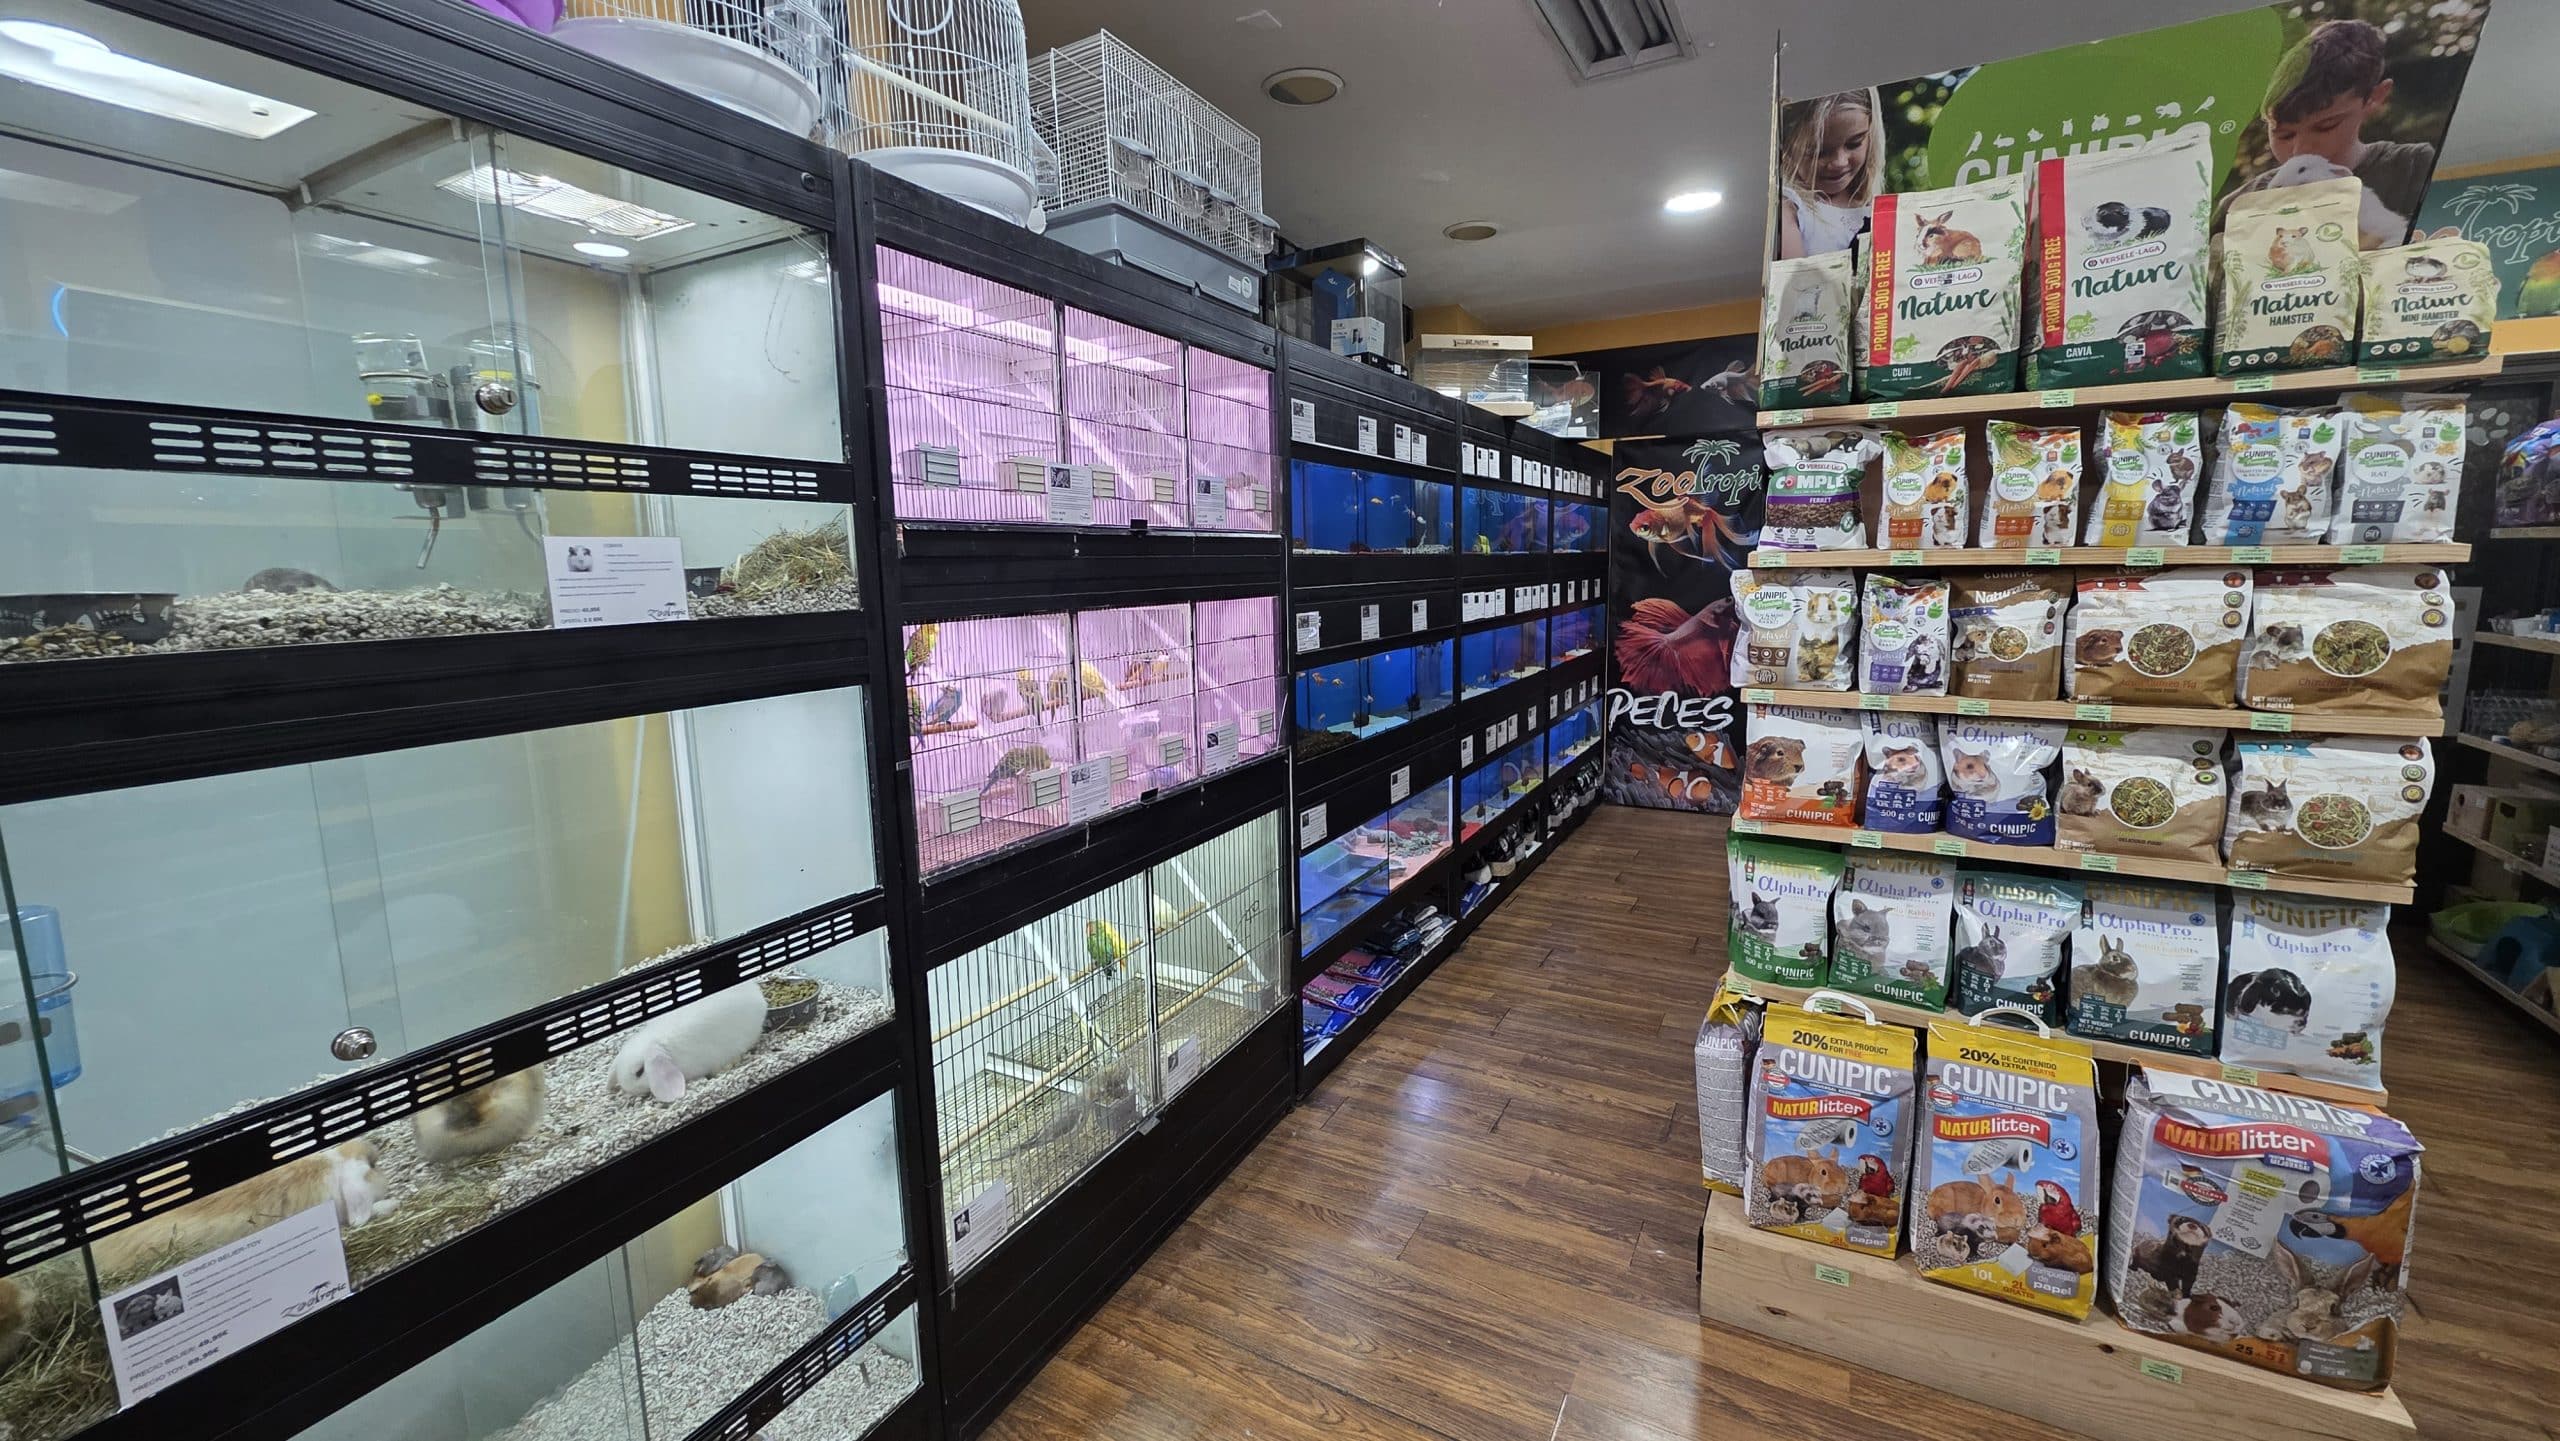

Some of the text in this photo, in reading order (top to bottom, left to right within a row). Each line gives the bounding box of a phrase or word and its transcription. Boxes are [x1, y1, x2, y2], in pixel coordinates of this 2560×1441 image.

[2044, 236, 2060, 258] FREE
[2099, 245, 2161, 265] VERSELE-LAGA
[1876, 250, 1891, 278] FREE
[2046, 268, 2061, 290] 500
[2072, 261, 2184, 298] Nature
[1880, 288, 1890, 309] 500
[1898, 288, 1998, 320] Nature
[2251, 290, 2339, 316] Nature
[2392, 293, 2474, 313] Nature
[2046, 290, 2061, 332] PROMO
[2270, 313, 2314, 327] HAMSTER
[2401, 310, 2459, 322] MINI HAMSTER
[1874, 311, 1888, 351] PROMO
[1780, 334, 1838, 352] Nature
[2066, 346, 2092, 358] CAVIA
[1892, 368, 1912, 378] CUNI
[2244, 450, 2276, 458] CUNIPIC
[2364, 450, 2400, 458] CUNIPIC
[1754, 591, 1787, 600] CUNIPIC
[1606, 687, 1734, 732] PECES
[1818, 710, 1842, 722] Pro
[1786, 809, 1834, 822] CUNIPIC
[1990, 823, 2036, 834] CUNIPIC
[1758, 875, 1804, 897] Alpha
[1858, 877, 1932, 898] Alpha Pro
[1980, 900, 2066, 928] Alpha Pro
[2251, 896, 2369, 928] CUNIPIC
[2099, 912, 2192, 937] Alpha Pro
[2267, 932, 2352, 955] Alpha Pro
[1776, 966, 1814, 978] CUNIPIC
[1874, 984, 1924, 1002] CUNIPIC
[1792, 1030, 1828, 1050] 20%
[1830, 1037, 1888, 1056] EXTRA PRODUCT
[2129, 1030, 2190, 1048] CUNIPIC
[1829, 1046, 1844, 1054] FOR
[1960, 1048, 2000, 1066] 20%
[1780, 1048, 1892, 1095] CUNIPIC
[2002, 1062, 2056, 1078] EXTRA GRATIS
[2012, 1056, 2057, 1070] CONTENIDO
[1942, 1062, 2068, 1112] CUNIPIC
[1772, 1098, 1864, 1117] NATURlitter
[1940, 1117, 2041, 1137] NATURlitter
[2164, 1124, 2316, 1153] NATURlitter
[1850, 1236, 1887, 1247] paper
[1971, 1268, 1997, 1284] 10L
[2011, 1280, 2024, 1290] 2L
[2034, 1280, 2072, 1296] papel
[2003, 1286, 2036, 1300] GRATIS
[2234, 1344, 2254, 1356] 25
[130, 1362, 164, 1382] PRECIO
[132, 1374, 166, 1393] PRECIO
